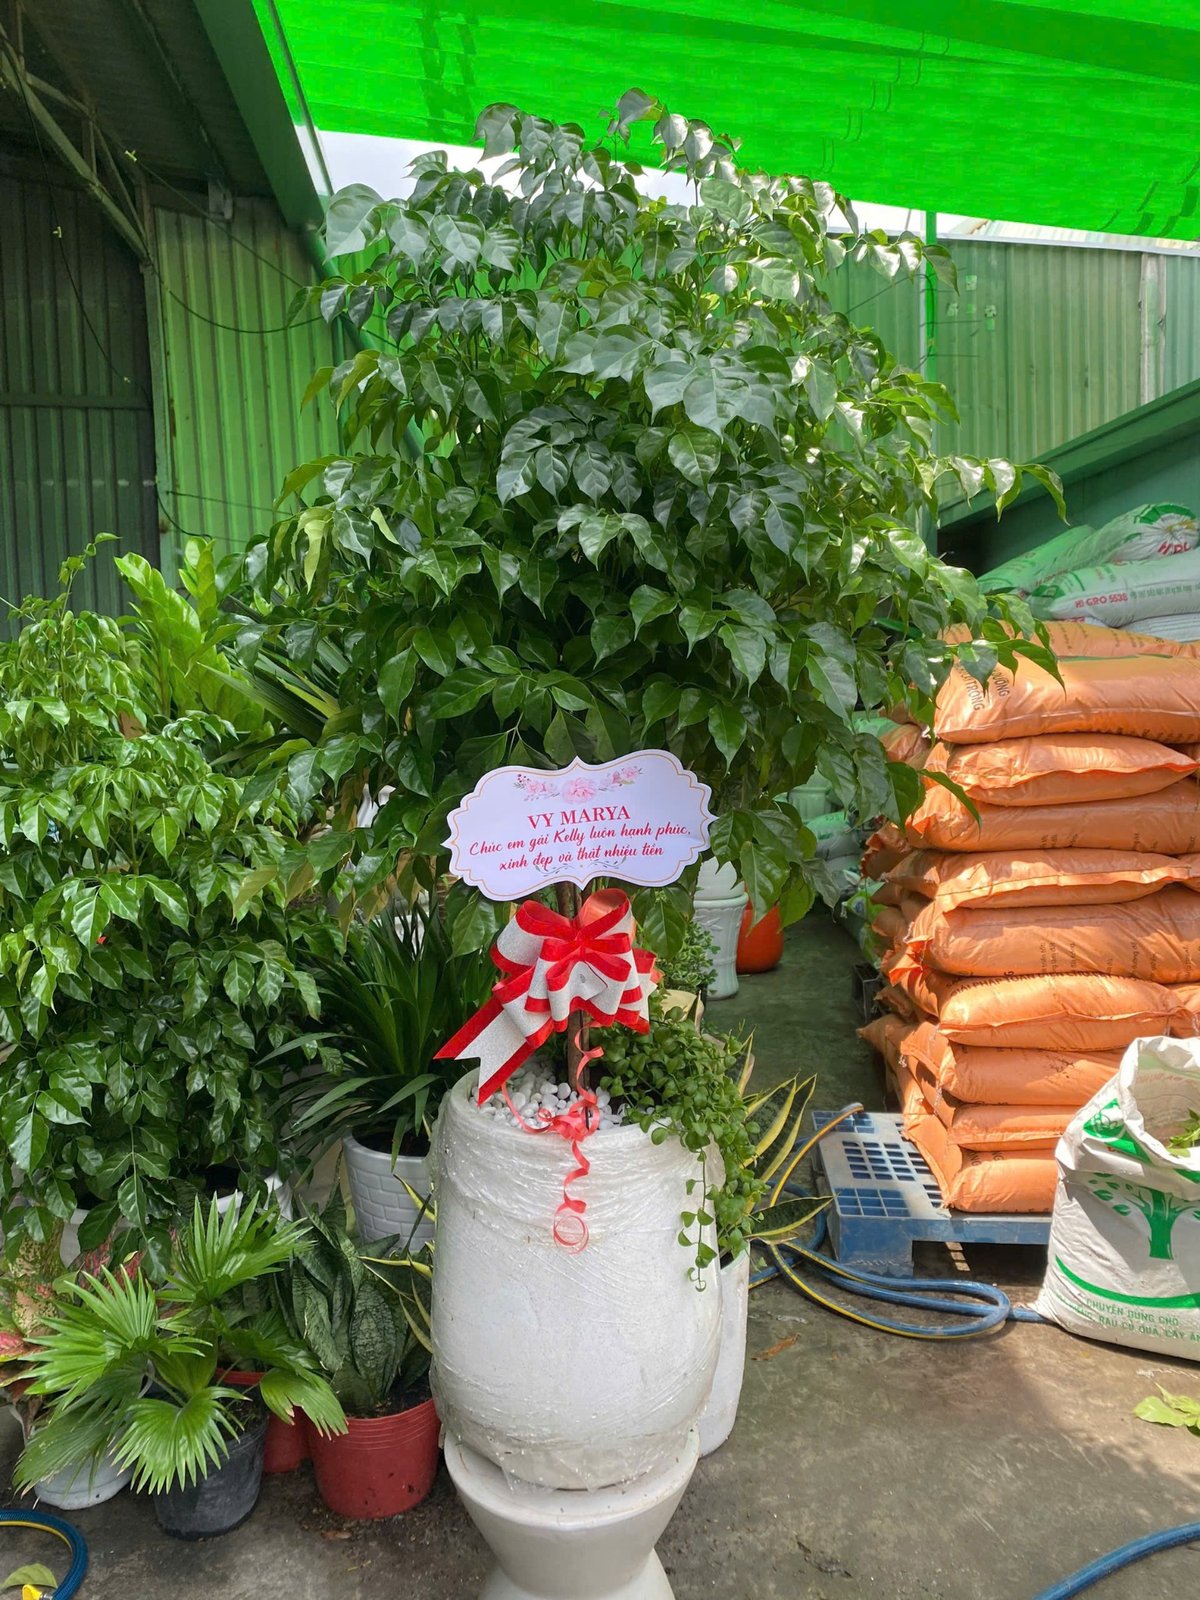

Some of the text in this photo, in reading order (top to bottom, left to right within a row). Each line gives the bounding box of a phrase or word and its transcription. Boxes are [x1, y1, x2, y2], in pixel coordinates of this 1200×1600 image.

[1086, 596, 1107, 606] GRO
[528, 805, 631, 829] VY MARYA
[469, 821, 691, 855] Chúc em gái Kelly luôn hạnh phúc,
[499, 842, 664, 872] xinh đẹp và thật nhiều tiền
[1087, 1298, 1123, 1316] CHUYÊN
[1158, 1316, 1179, 1326] CHO
[1098, 1315, 1117, 1328] RAU
